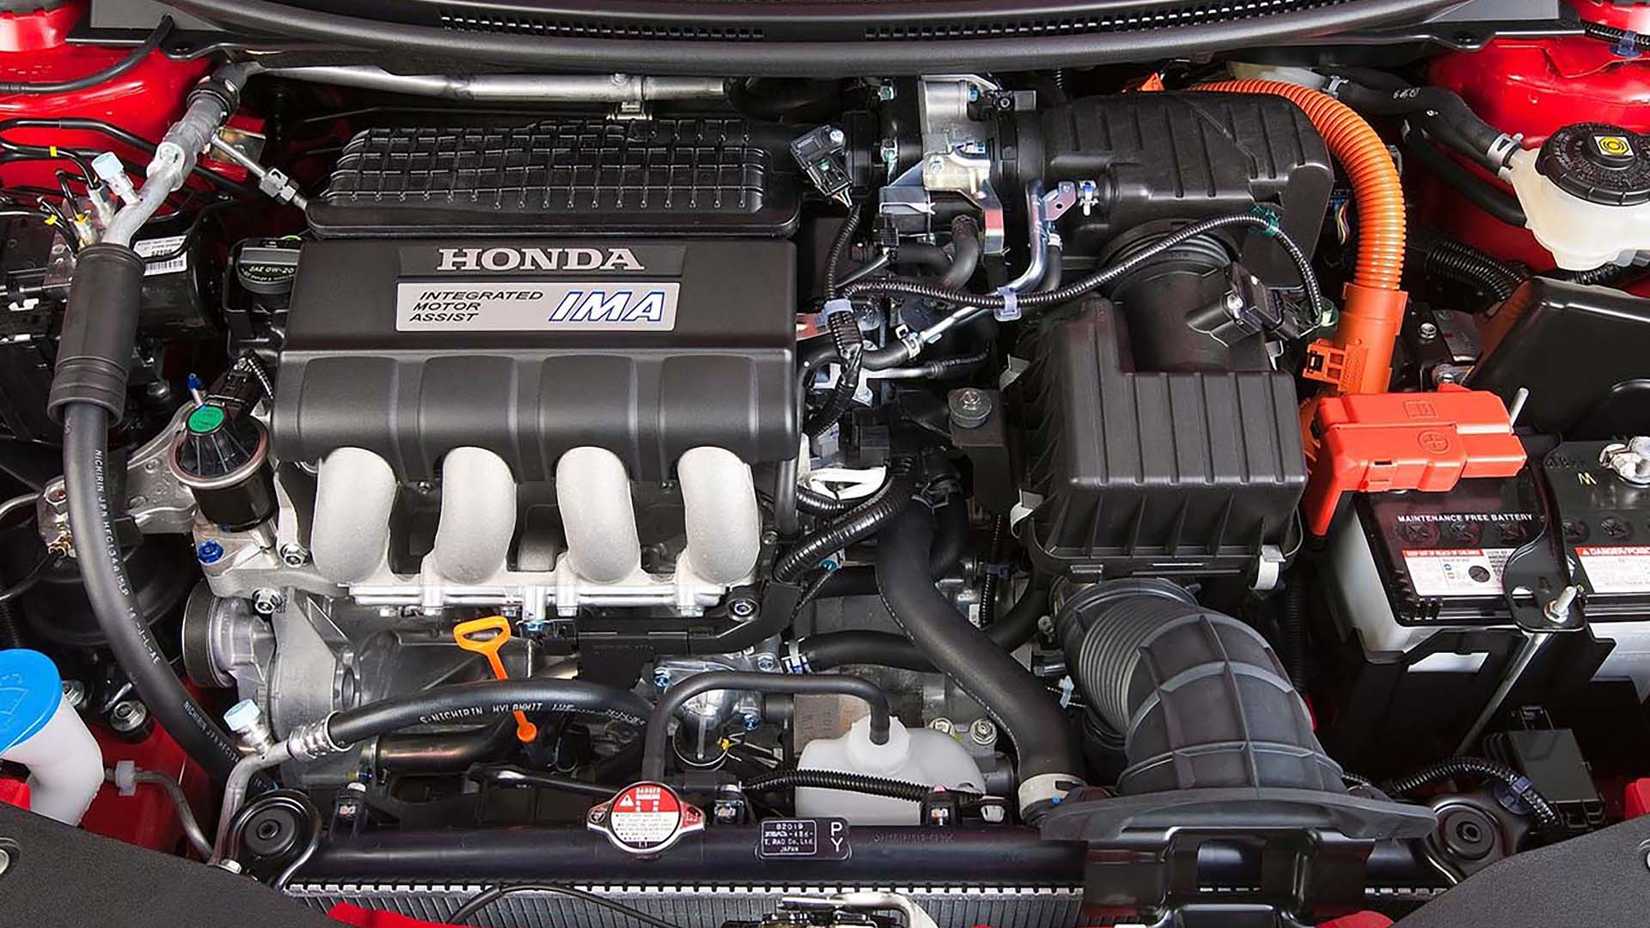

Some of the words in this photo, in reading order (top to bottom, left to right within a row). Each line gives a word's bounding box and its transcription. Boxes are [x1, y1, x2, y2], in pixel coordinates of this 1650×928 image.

[437, 247, 645, 271] HONDA
[419, 291, 543, 301] INTEGRATED
[412, 302, 481, 311] MOTOR
[548, 290, 666, 322] IMA
[409, 313, 479, 322] ASSIST
[1397, 513, 1462, 523] MAINTENANCE
[1464, 513, 1490, 522] FREE
[1491, 512, 1533, 522] BATTERY
